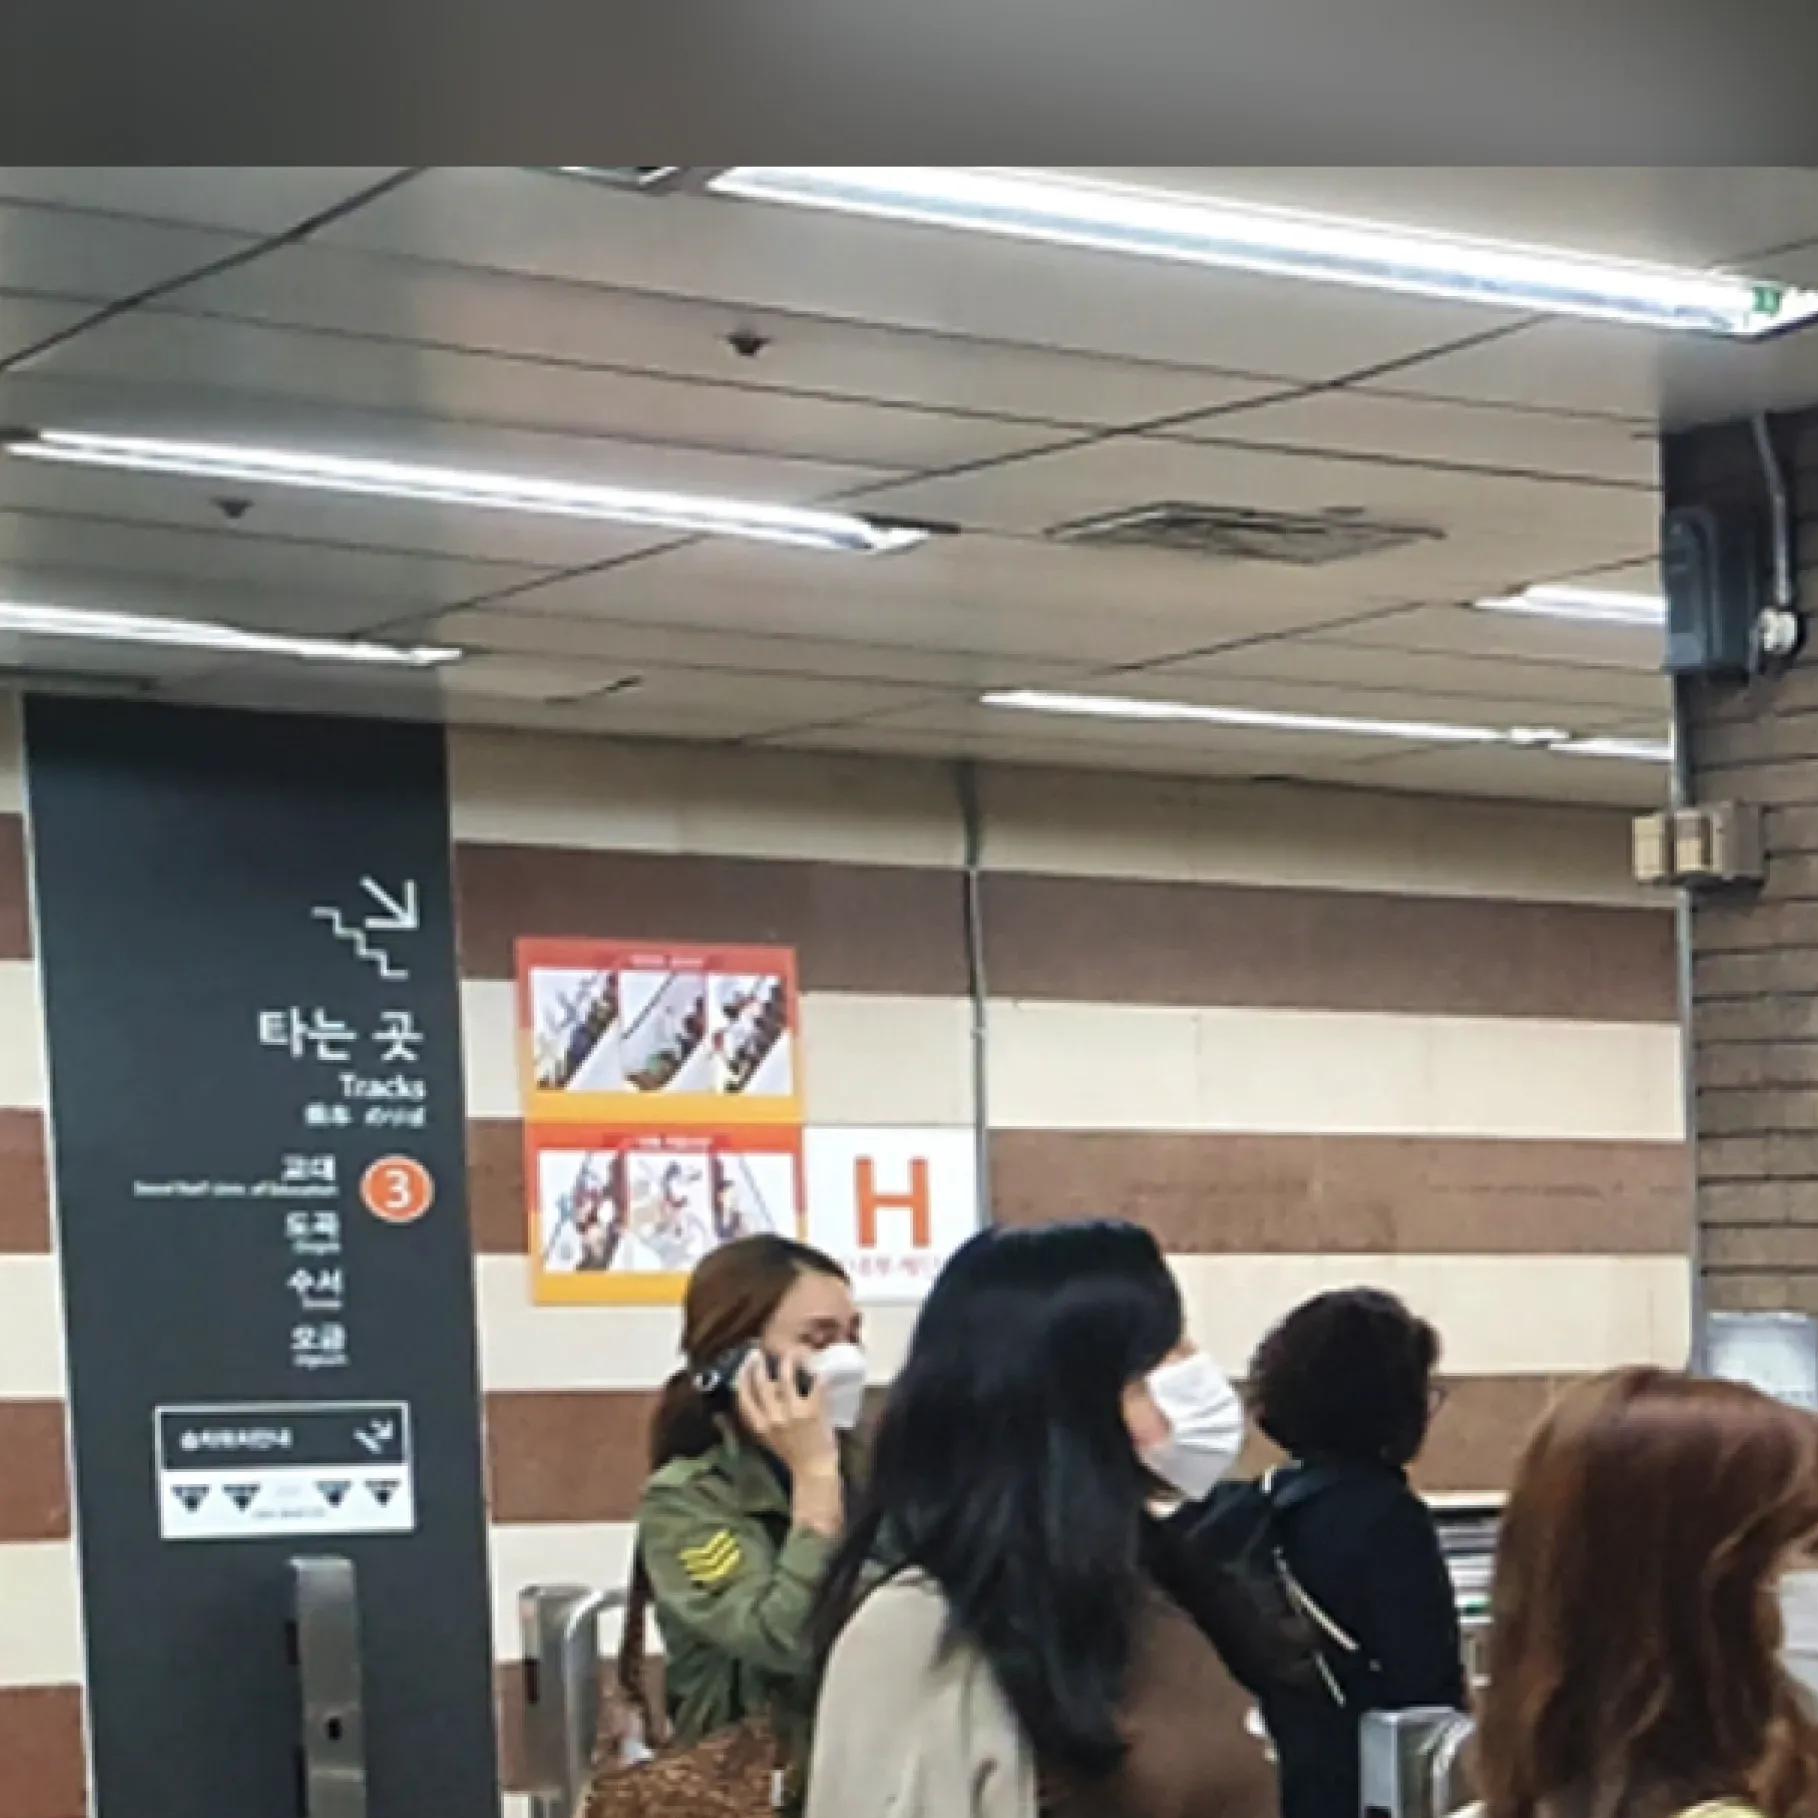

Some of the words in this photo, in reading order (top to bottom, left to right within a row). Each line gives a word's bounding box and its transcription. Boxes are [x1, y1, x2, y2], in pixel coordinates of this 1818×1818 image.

[259, 1006, 357, 1059] 타는
[372, 1011, 424, 1061] 곳
[339, 1073, 425, 1099] Tracks
